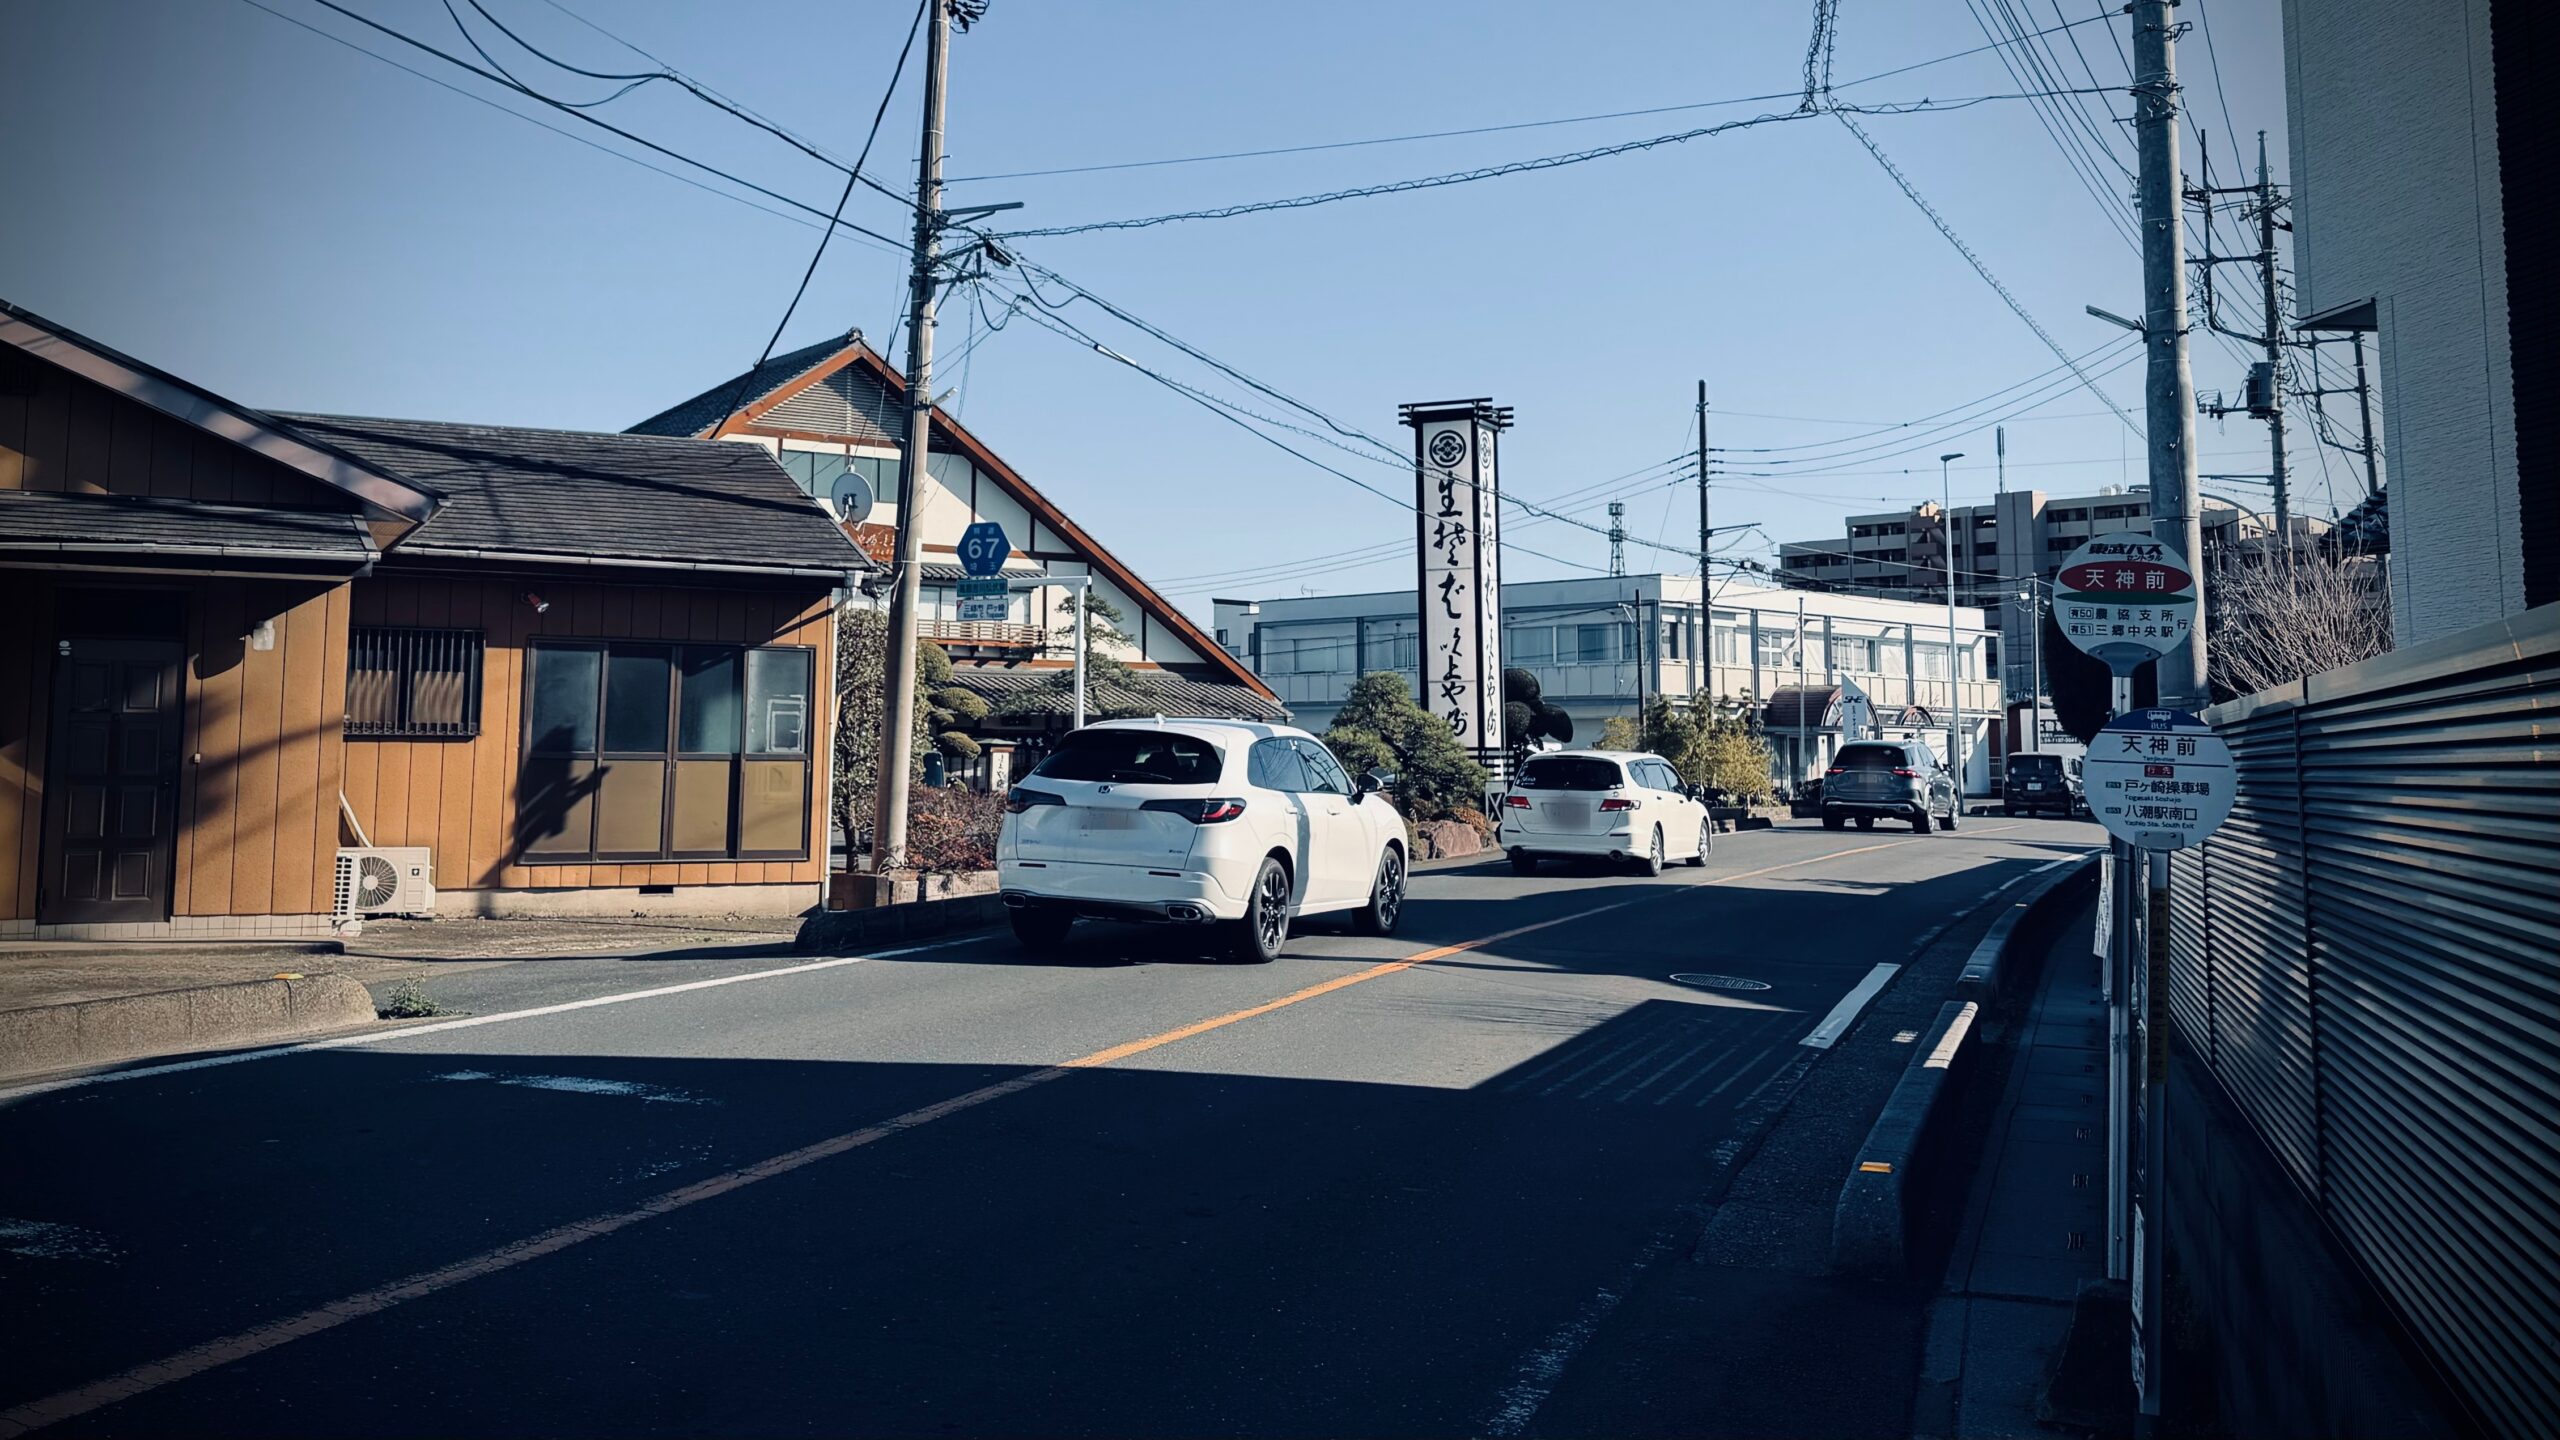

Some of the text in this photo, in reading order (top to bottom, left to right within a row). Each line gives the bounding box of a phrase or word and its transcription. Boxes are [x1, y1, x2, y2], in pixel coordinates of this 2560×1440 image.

[968, 538, 1000, 559] 67
[2088, 543, 2163, 555] 東武バス
[2126, 554, 2163, 562] セントラル
[2085, 569, 2165, 590] 天神前
[2095, 608, 2174, 621] 農協支所
[2095, 624, 2174, 638] 三郷中央駅
[2177, 619, 2188, 630] 行
[2151, 722, 2167, 730] BUS
[2121, 735, 2197, 756] 天神前
[2147, 766, 2171, 775] 行先
[2124, 804, 2198, 821] 八潮駅南口
